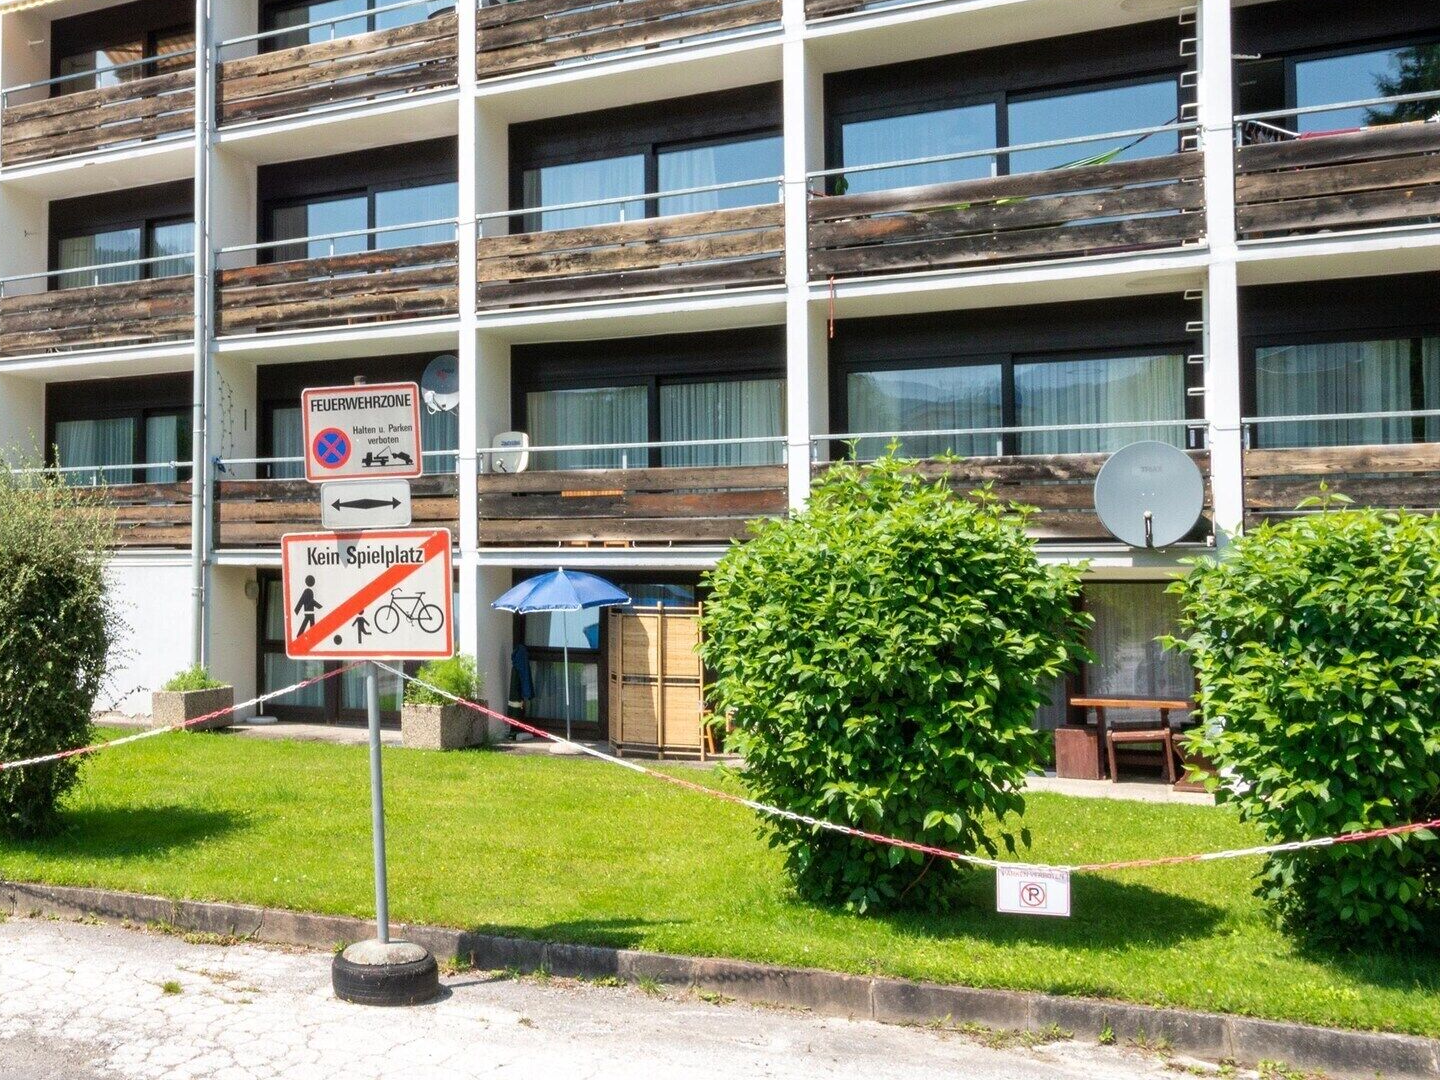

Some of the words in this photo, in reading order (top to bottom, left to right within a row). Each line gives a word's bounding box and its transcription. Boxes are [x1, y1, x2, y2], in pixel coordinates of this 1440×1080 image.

[311, 394, 412, 412] FEUERWEHRZONE
[353, 426, 376, 435] Halten
[378, 426, 386, 434] u.
[388, 423, 413, 433] Parken
[367, 435, 400, 445] verboten
[307, 546, 340, 565] Kein
[346, 544, 424, 569] Spielplatz
